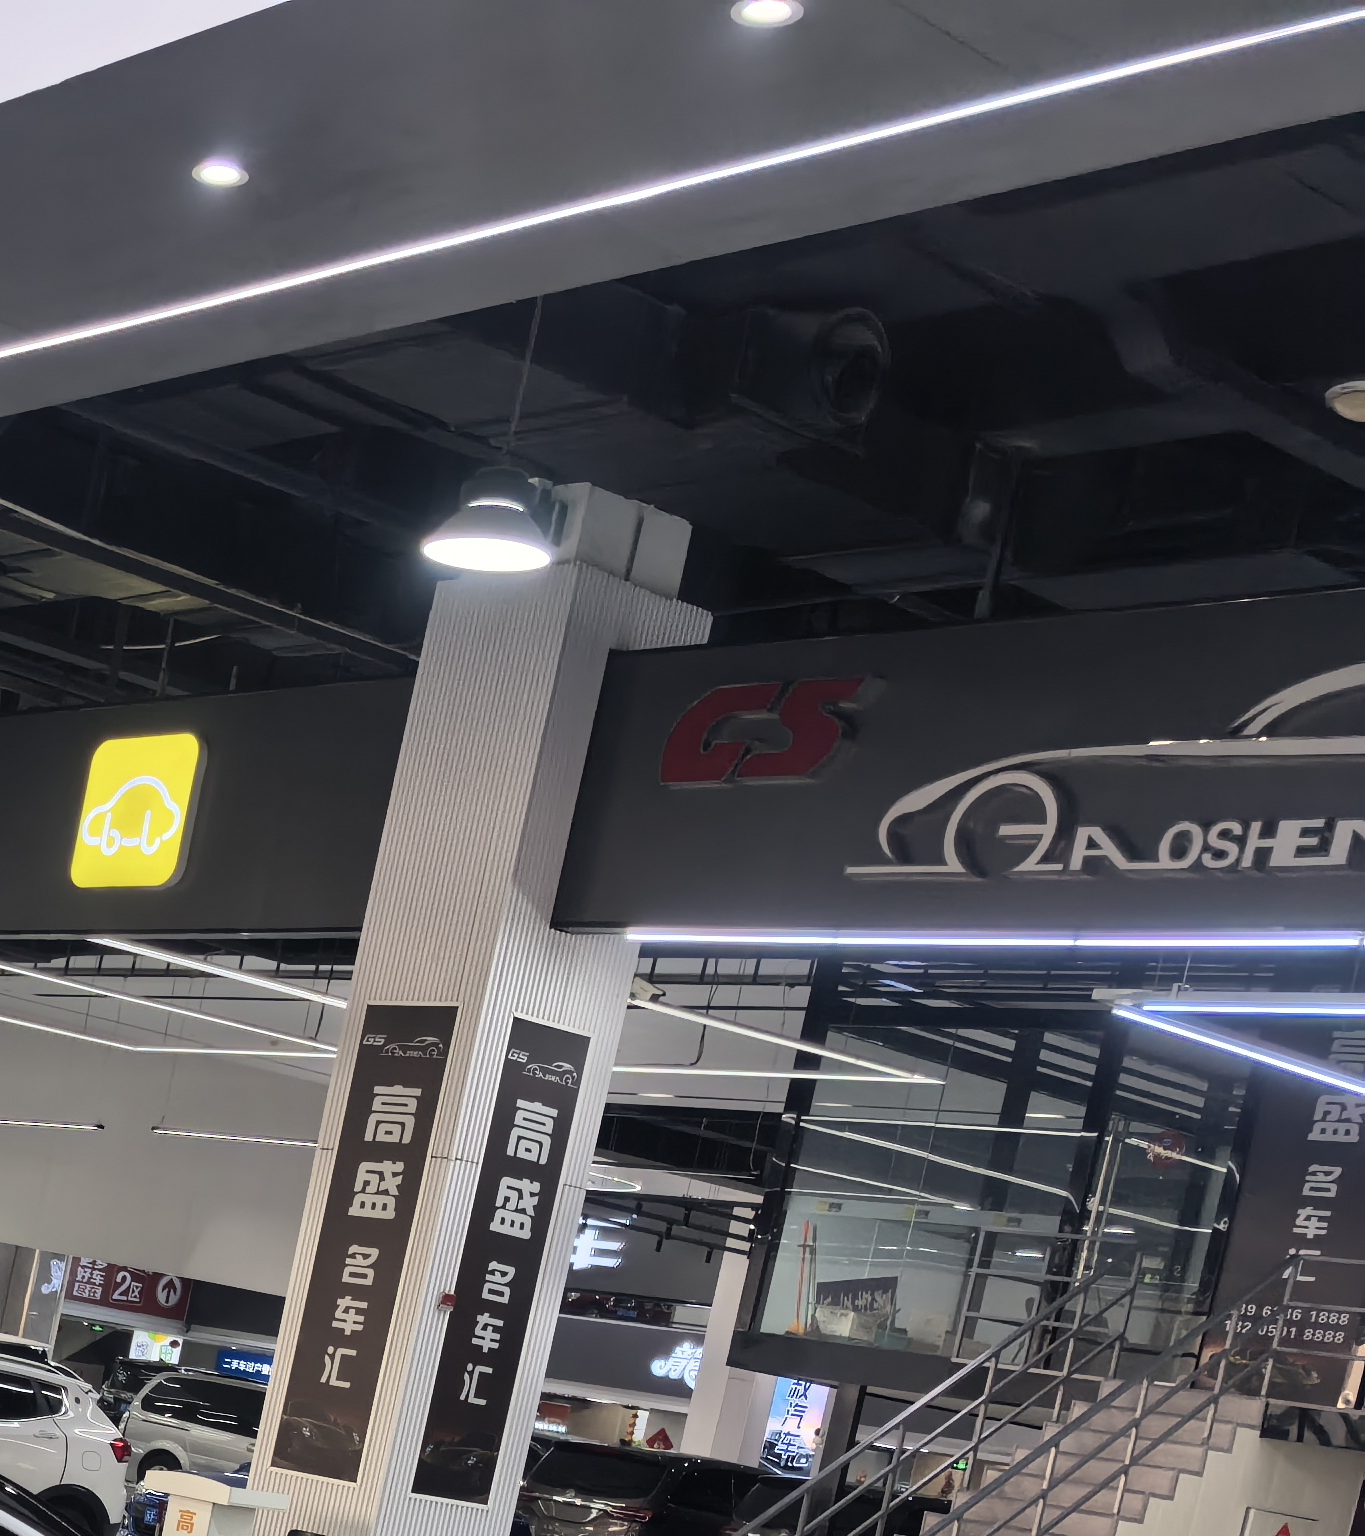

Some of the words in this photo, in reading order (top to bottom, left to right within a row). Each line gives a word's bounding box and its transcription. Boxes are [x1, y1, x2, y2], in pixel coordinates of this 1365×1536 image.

[320, 1084, 422, 1389] 高盛名车汇
[459, 1099, 558, 1406] 高盛名车汇
[112, 1271, 143, 1302] 2区
[1309, 1310, 1350, 1326] 1888
[1303, 1328, 1345, 1344] 8888
